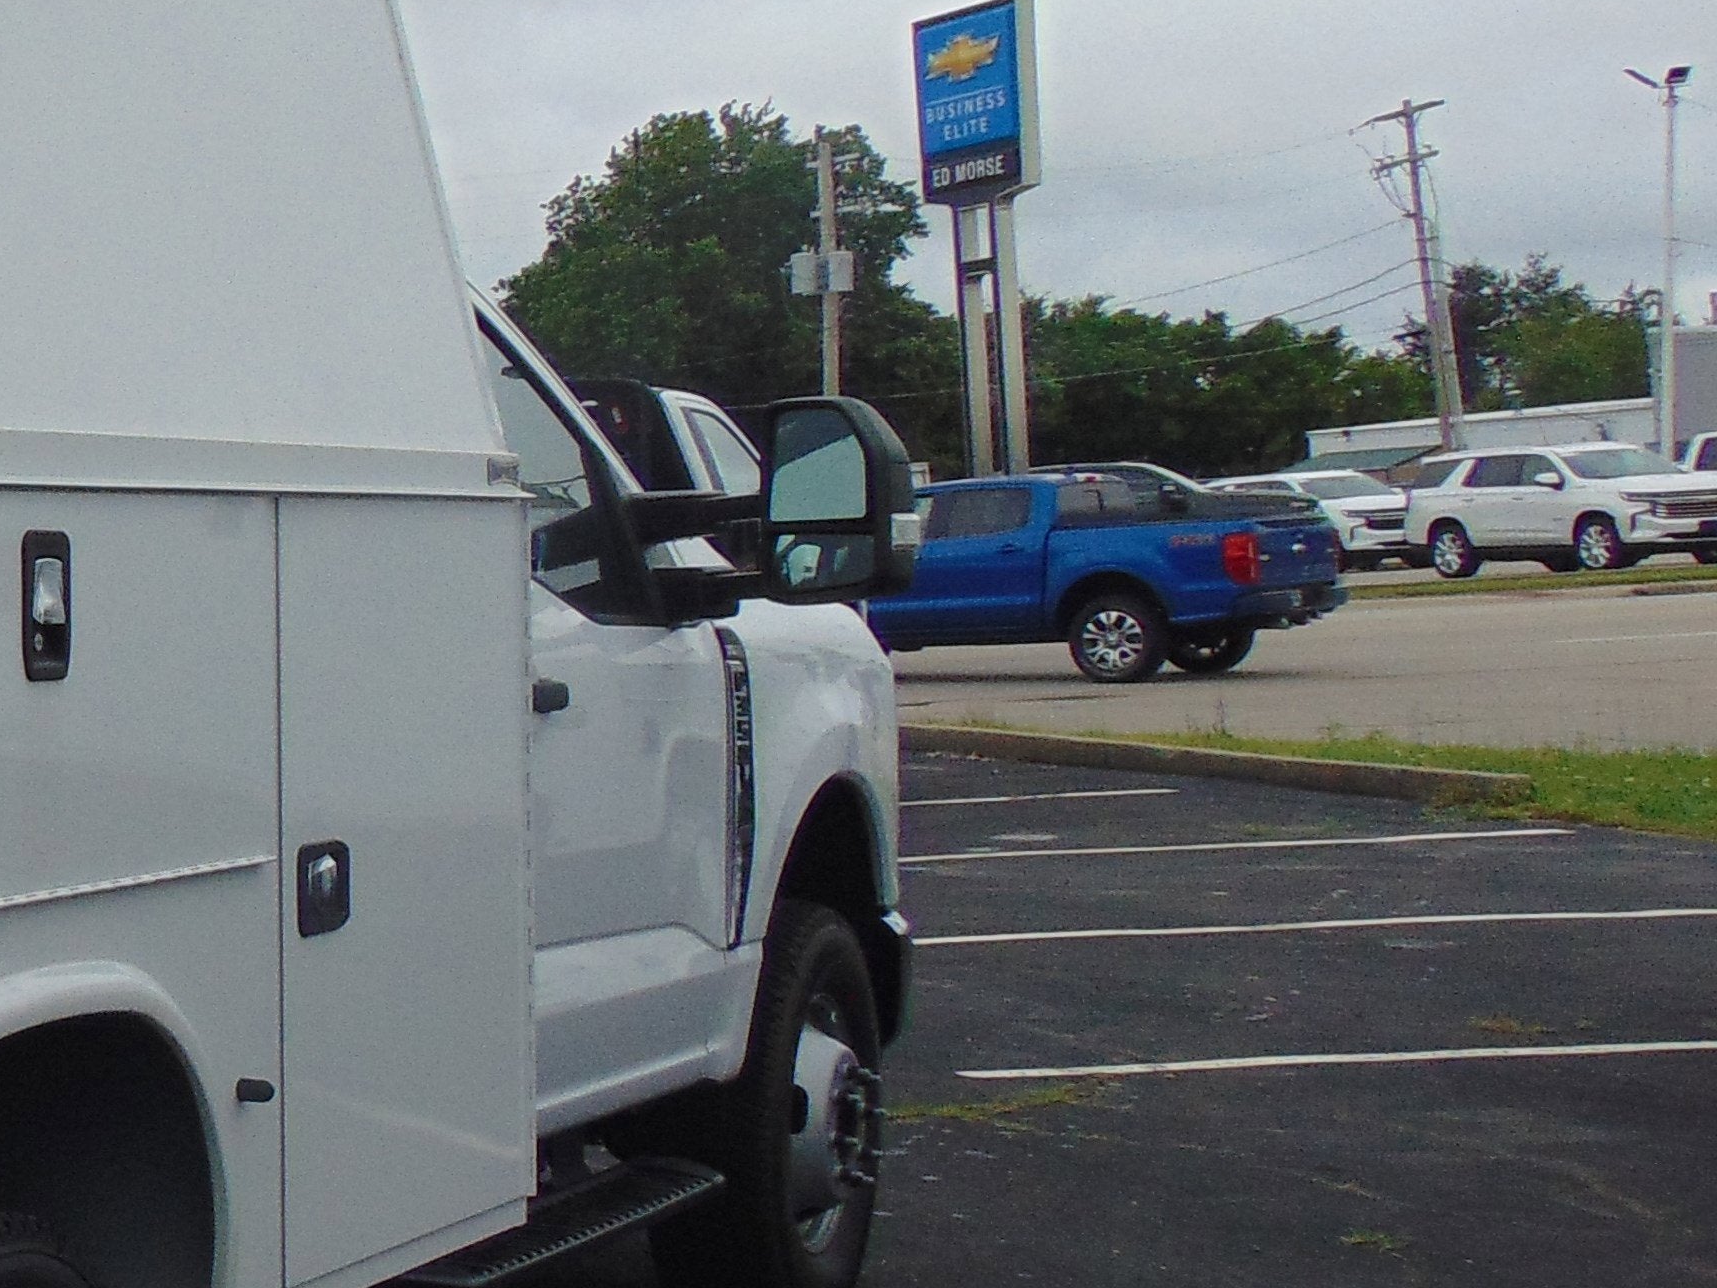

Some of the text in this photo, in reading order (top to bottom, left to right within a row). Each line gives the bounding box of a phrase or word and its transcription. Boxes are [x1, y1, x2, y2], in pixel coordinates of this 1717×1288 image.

[925, 90, 1006, 125] BUSINESS
[943, 116, 990, 142] ELITE
[932, 154, 1006, 188] ED MORSE
